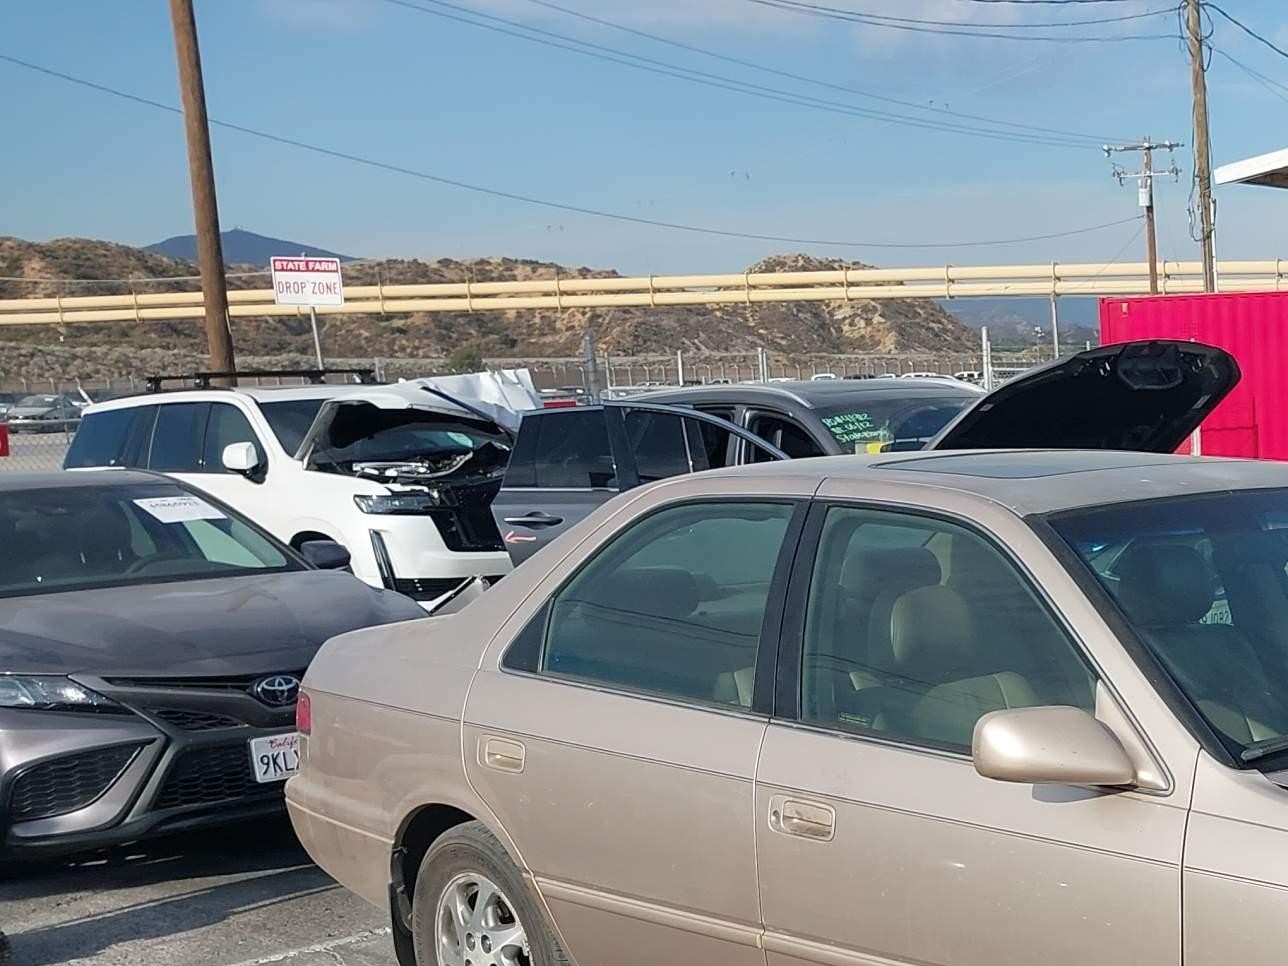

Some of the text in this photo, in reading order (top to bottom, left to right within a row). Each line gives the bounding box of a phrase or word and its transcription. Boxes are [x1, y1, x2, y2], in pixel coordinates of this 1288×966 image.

[274, 260, 337, 271] STATE FARM
[278, 281, 338, 295] DROP ZONE
